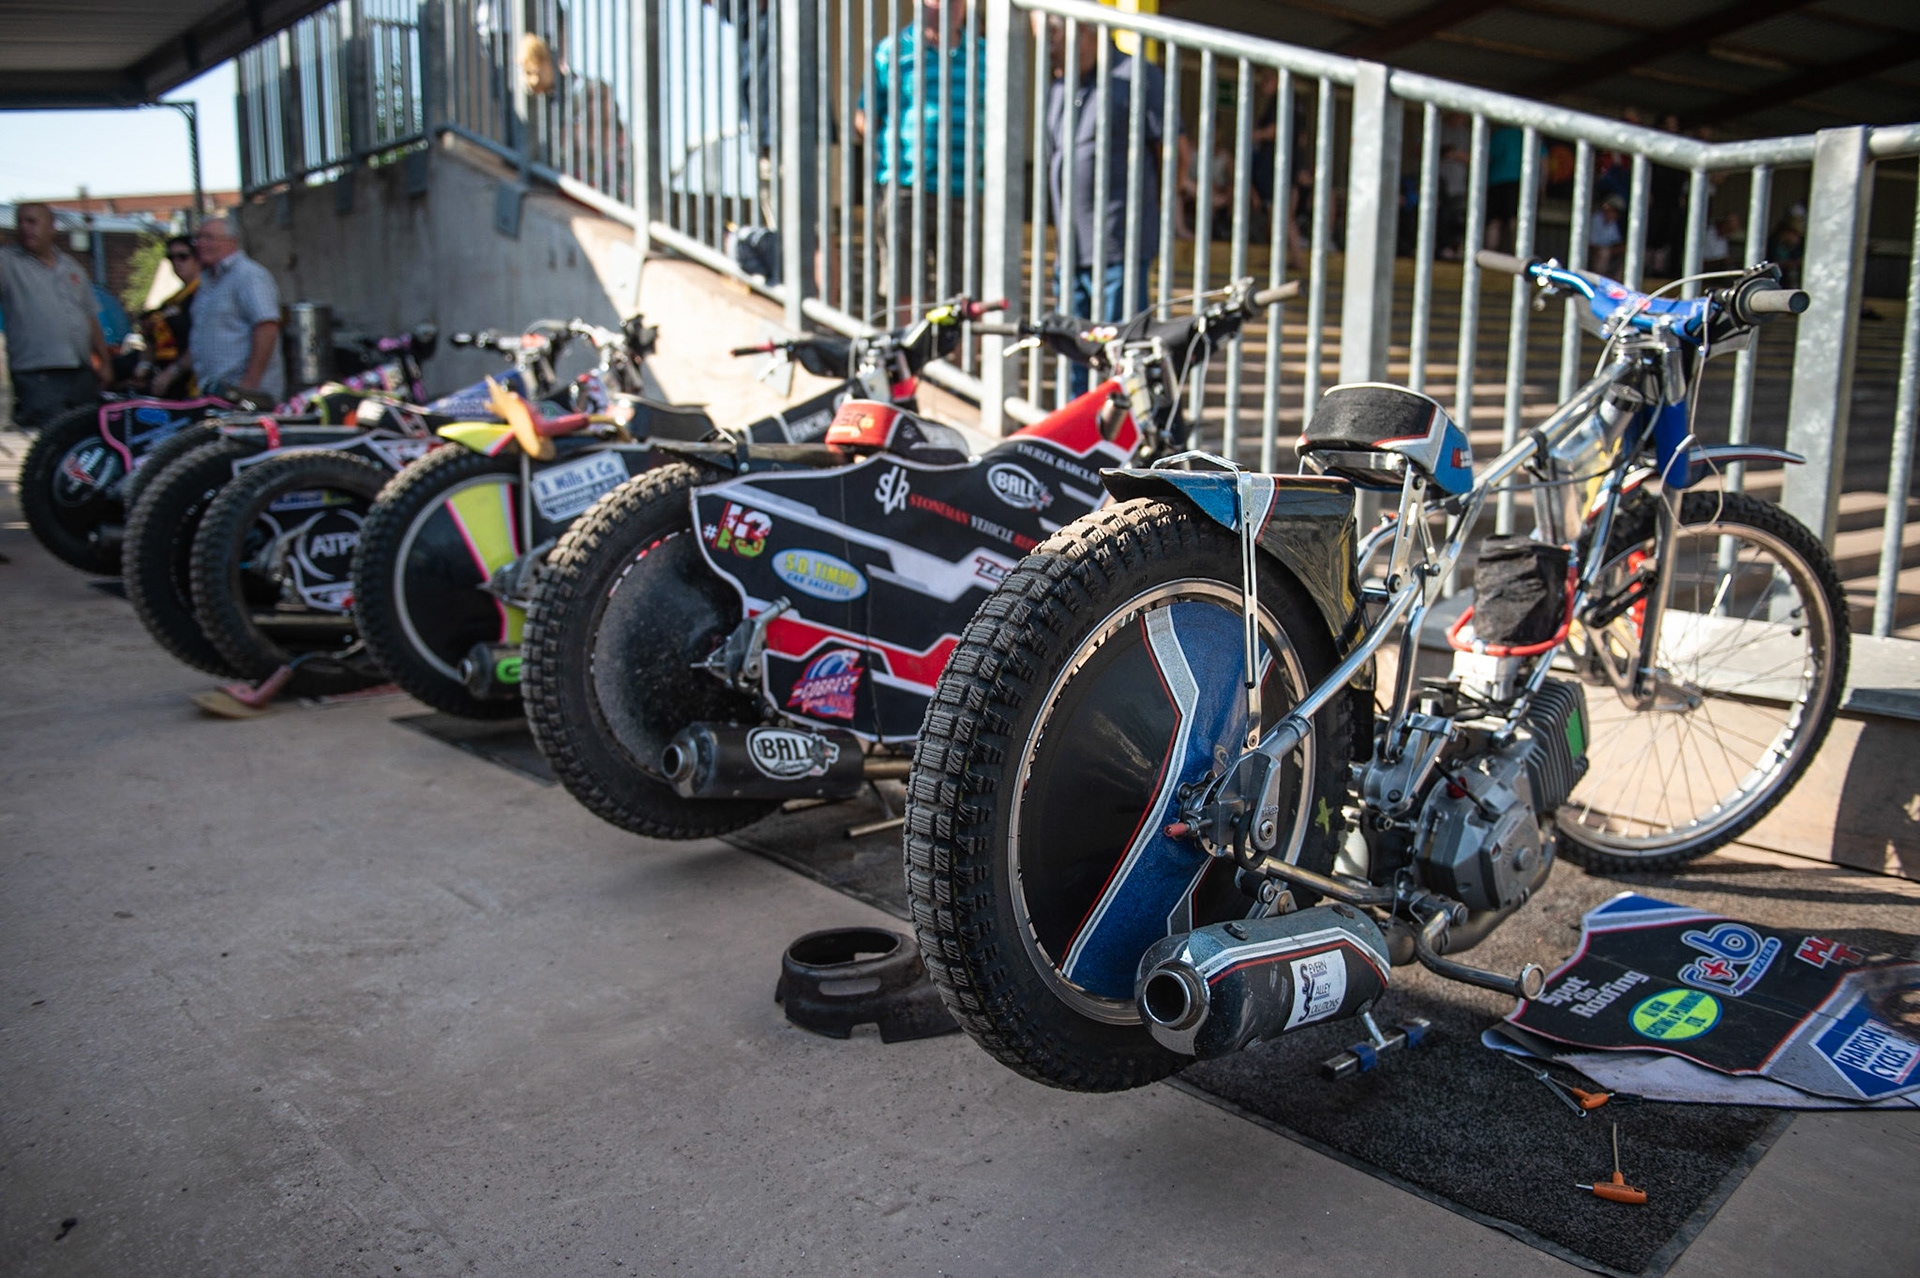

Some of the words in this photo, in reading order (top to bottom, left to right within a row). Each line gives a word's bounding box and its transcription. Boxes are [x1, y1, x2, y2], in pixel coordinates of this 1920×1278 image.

[994, 470, 1034, 499] BALL
[970, 514, 1015, 544] VEHICLE
[1538, 975, 1591, 1008] Spot
[1569, 970, 1650, 1019] Roofing
[1574, 987, 1599, 1003] On
[1868, 1044, 1913, 1079] CYCLES
